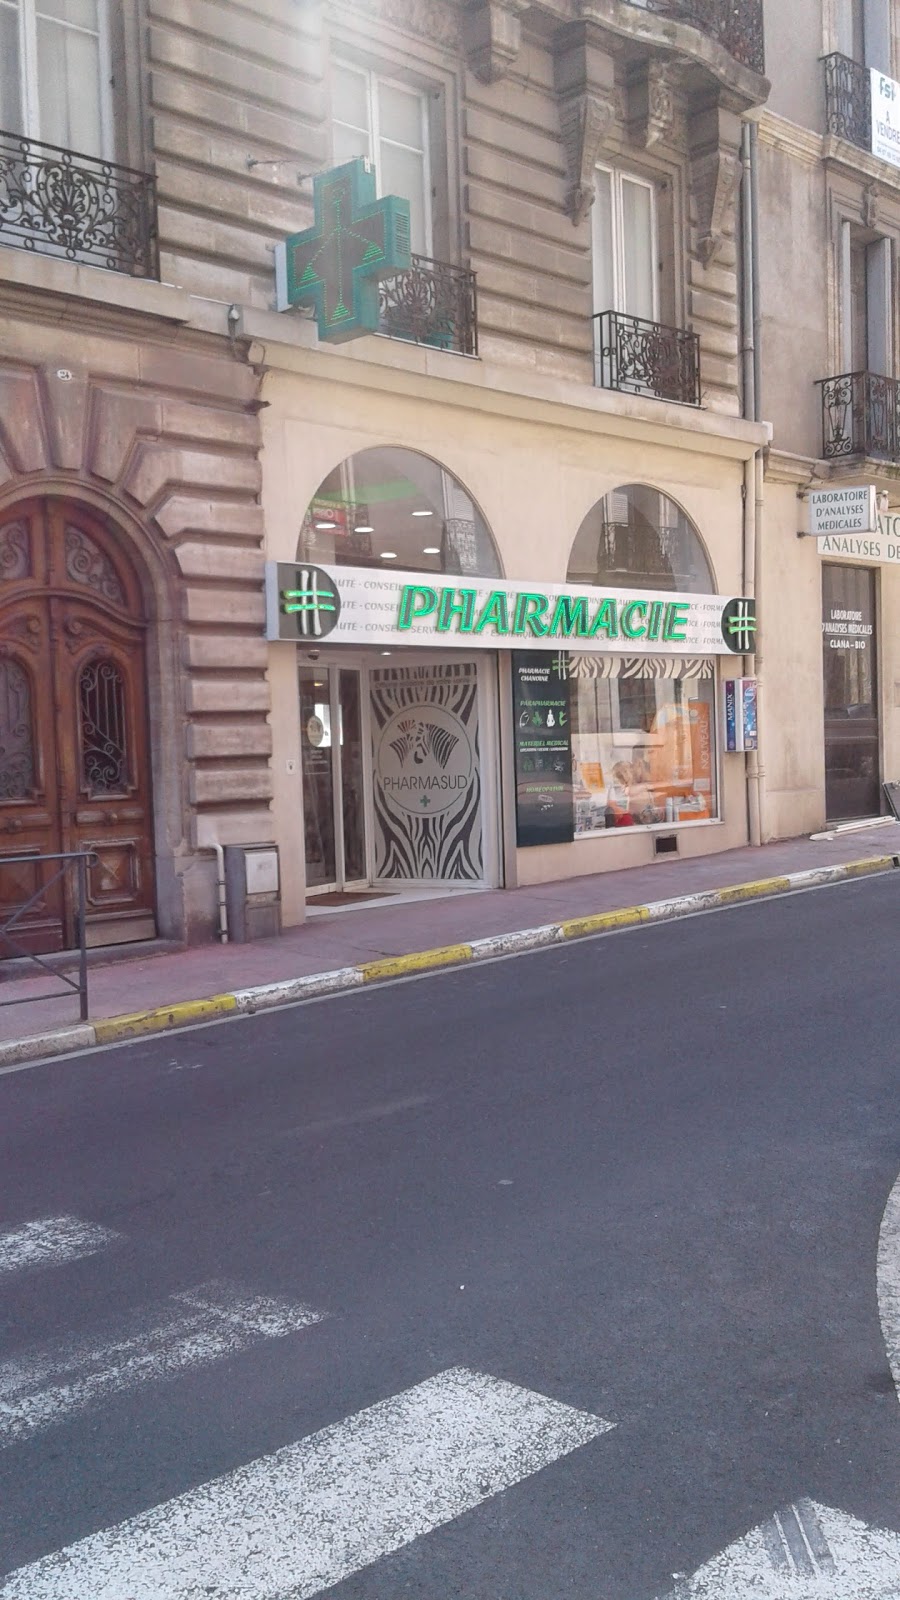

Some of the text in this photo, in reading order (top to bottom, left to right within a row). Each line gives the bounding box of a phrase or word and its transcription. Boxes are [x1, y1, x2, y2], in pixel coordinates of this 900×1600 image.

[812, 490, 868, 504] LABORATOIRE
[816, 504, 864, 517] D'ANALYSES
[817, 518, 862, 531] MEDICALES
[822, 534, 881, 556] ANALYSES
[399, 584, 691, 640] PHARMACIE
[830, 609, 862, 621] LABORATOIRE
[383, 774, 468, 791] PHARMASUD
